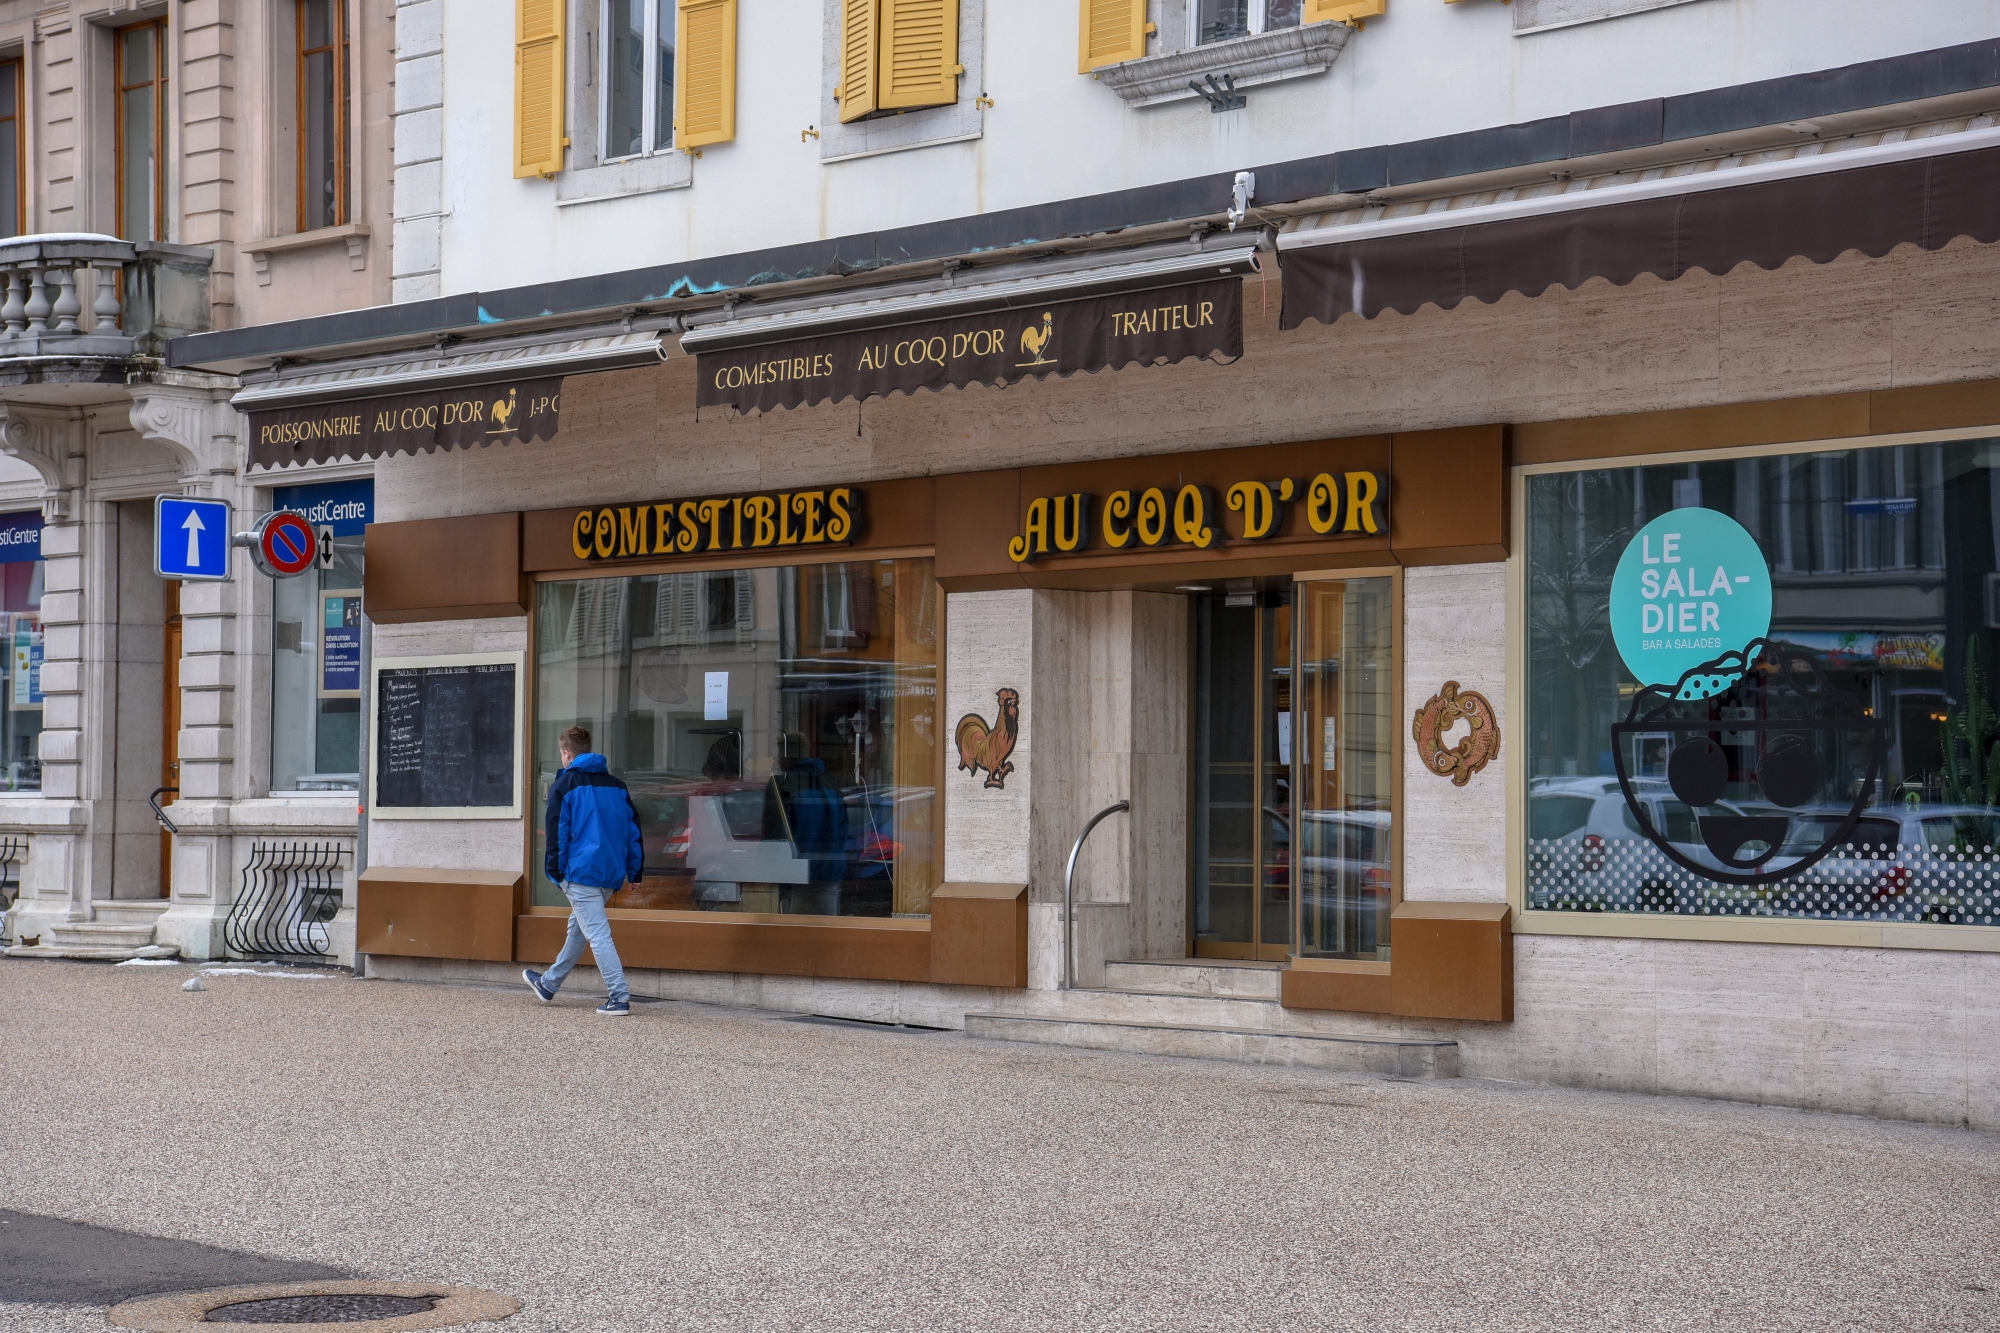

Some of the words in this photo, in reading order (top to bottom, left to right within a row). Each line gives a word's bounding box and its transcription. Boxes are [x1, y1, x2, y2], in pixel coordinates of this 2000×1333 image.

[715, 353, 833, 389] COMESTIBLES
[857, 345, 887, 371] AU
[894, 337, 948, 368] COQ
[952, 328, 1005, 359] D'OR
[1111, 301, 1214, 337] TRAITEUR
[261, 415, 361, 444] POISSONNERIE
[373, 410, 397, 433] AU
[400, 405, 437, 430] COQ
[442, 400, 484, 425] D'OR
[572, 488, 853, 560] COMESTIBLES
[1008, 493, 1083, 564] AU
[1101, 483, 1216, 549] COQ
[1225, 470, 1380, 539] D'OR
[1643, 533, 1681, 564] LE
[1641, 566, 1750, 599] SALA-
[1642, 601, 1720, 633] DIER
[1642, 639, 1663, 650] BAR
[1665, 639, 1672, 649] A
[1674, 637, 1722, 649] SALADES
